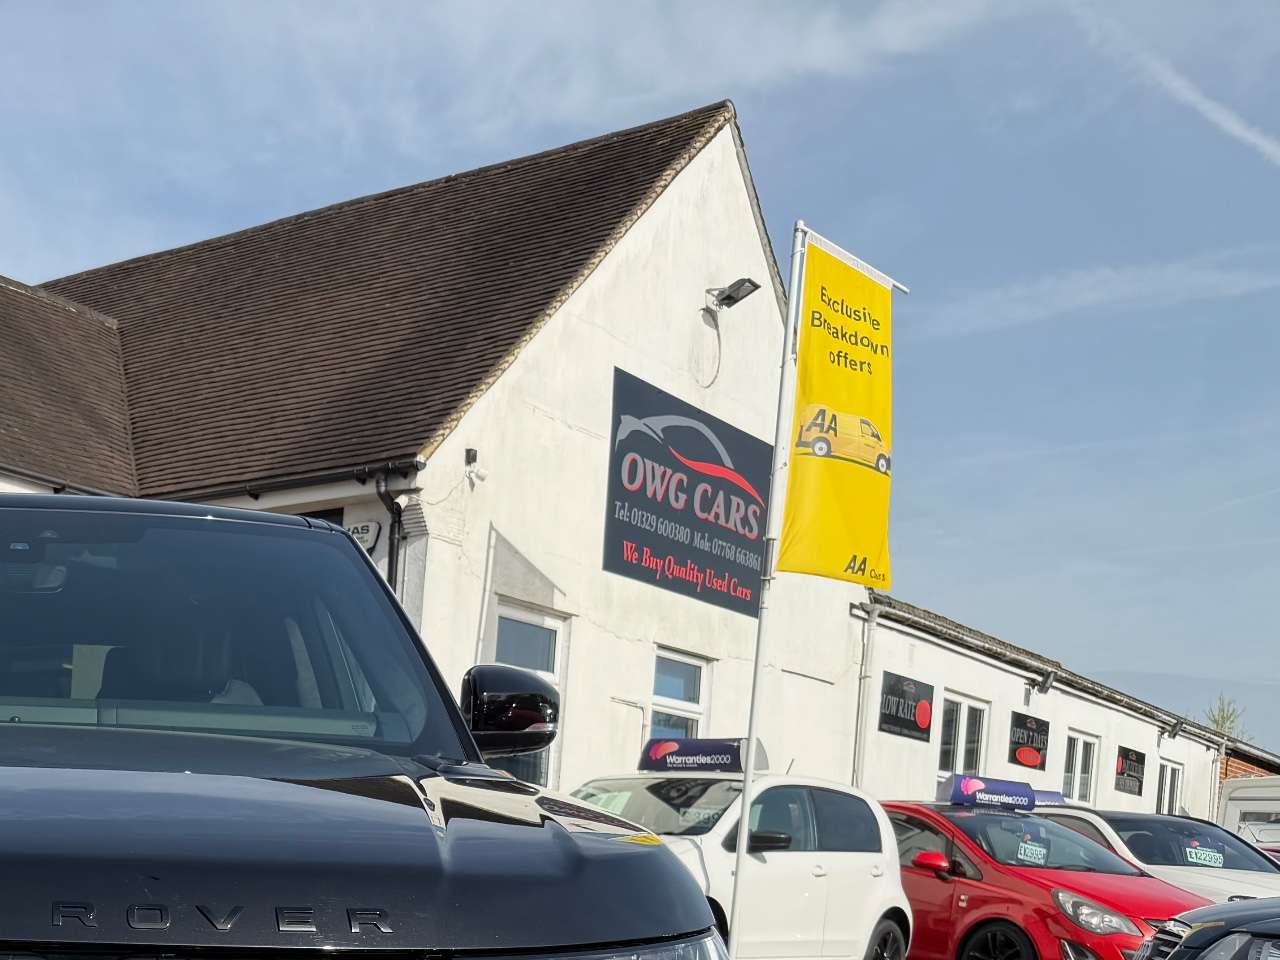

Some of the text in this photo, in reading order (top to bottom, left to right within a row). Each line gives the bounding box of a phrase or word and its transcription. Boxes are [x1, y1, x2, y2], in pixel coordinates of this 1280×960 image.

[821, 286, 881, 331] Exclusive
[829, 351, 873, 375] offers
[805, 408, 838, 437] AA
[621, 452, 761, 540] OWG CARS
[614, 500, 630, 522] Tel:
[631, 507, 657, 532] 01329
[658, 518, 691, 544] 600380
[623, 540, 752, 600] We Buy Quality Used Cars
[844, 554, 868, 576] AA
[881, 694, 899, 717] LOW
[51, 902, 395, 934] ROVER
